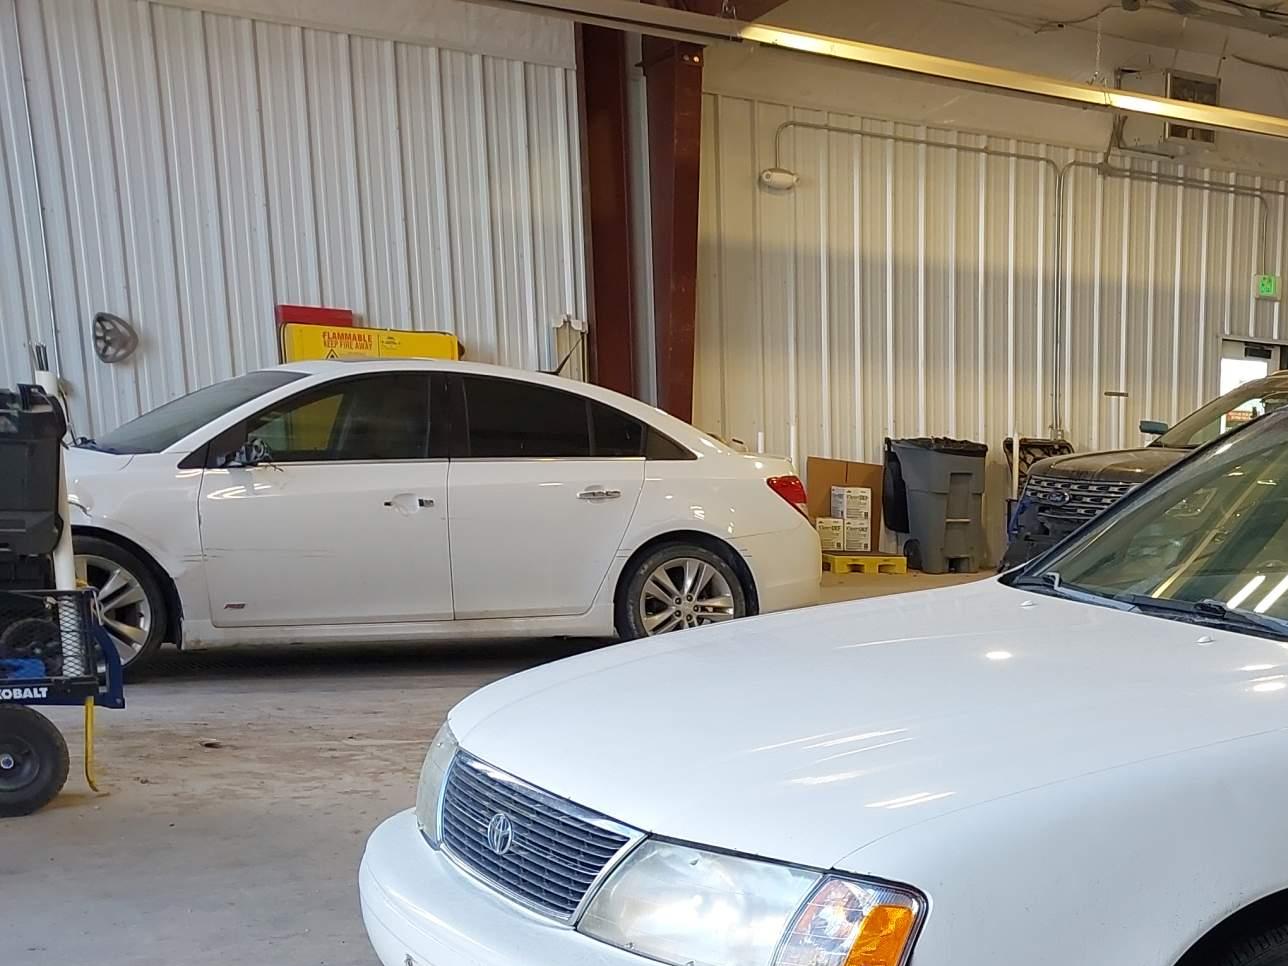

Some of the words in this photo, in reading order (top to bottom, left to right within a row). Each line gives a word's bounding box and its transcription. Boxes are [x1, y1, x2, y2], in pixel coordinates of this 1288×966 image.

[323, 331, 373, 343] FLAMMABLE
[323, 339, 339, 348] KEEP
[340, 341, 354, 350] FIRE
[355, 342, 373, 350] AWAY
